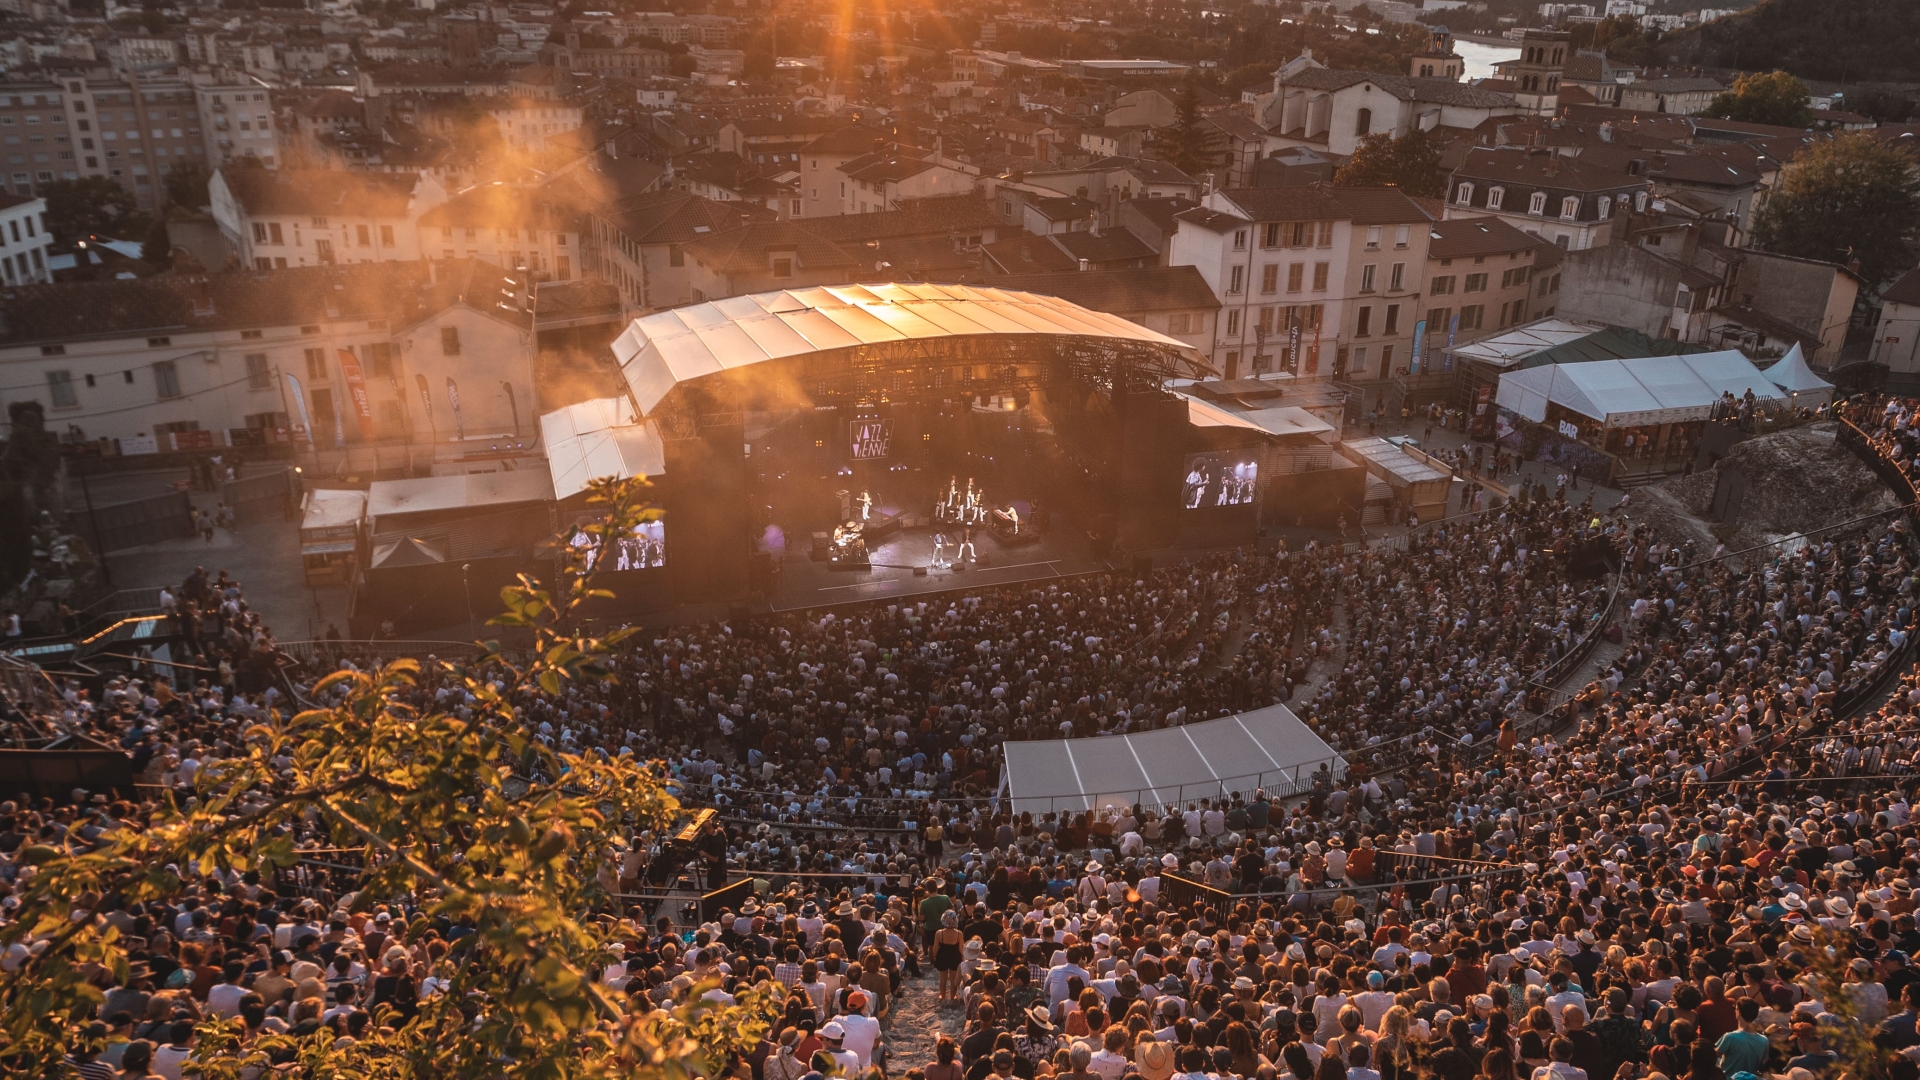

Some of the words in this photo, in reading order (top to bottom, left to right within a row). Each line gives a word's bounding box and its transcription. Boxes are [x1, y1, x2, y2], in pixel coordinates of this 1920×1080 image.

[359, 389, 370, 417] inter
[856, 423, 882, 443] JAZZ
[1559, 420, 1578, 440] BAR
[852, 438, 889, 457] VIENNE
